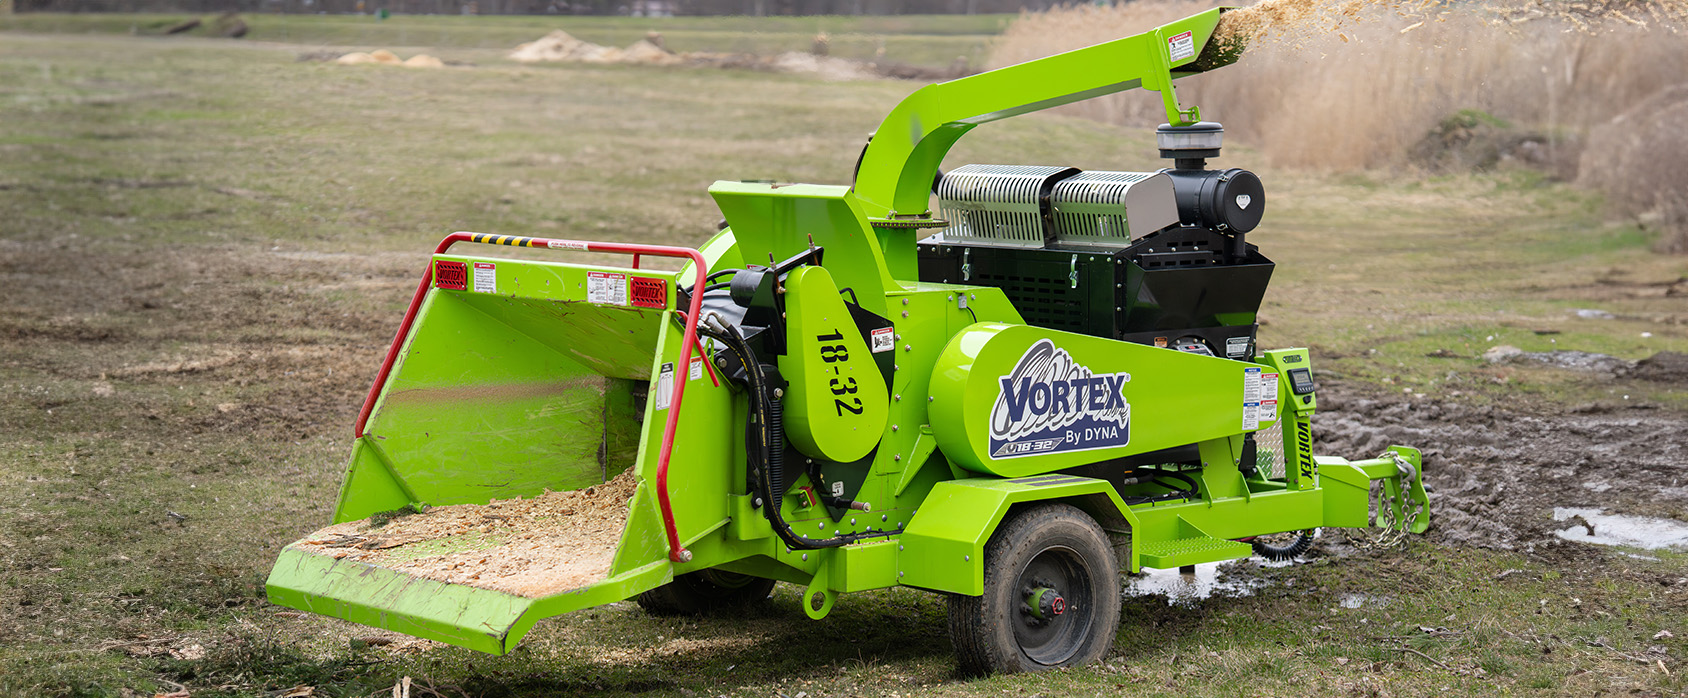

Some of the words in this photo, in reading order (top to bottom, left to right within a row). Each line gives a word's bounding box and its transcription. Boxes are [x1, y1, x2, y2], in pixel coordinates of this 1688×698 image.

[439, 269, 461, 281] VORTEX
[635, 286, 661, 299] VORTEX
[816, 328, 863, 417] 18-32
[1001, 375, 1126, 422] VORTEX
[1065, 430, 1081, 445] By
[1085, 427, 1119, 441] DYNA
[1297, 421, 1313, 480] VORTEX
